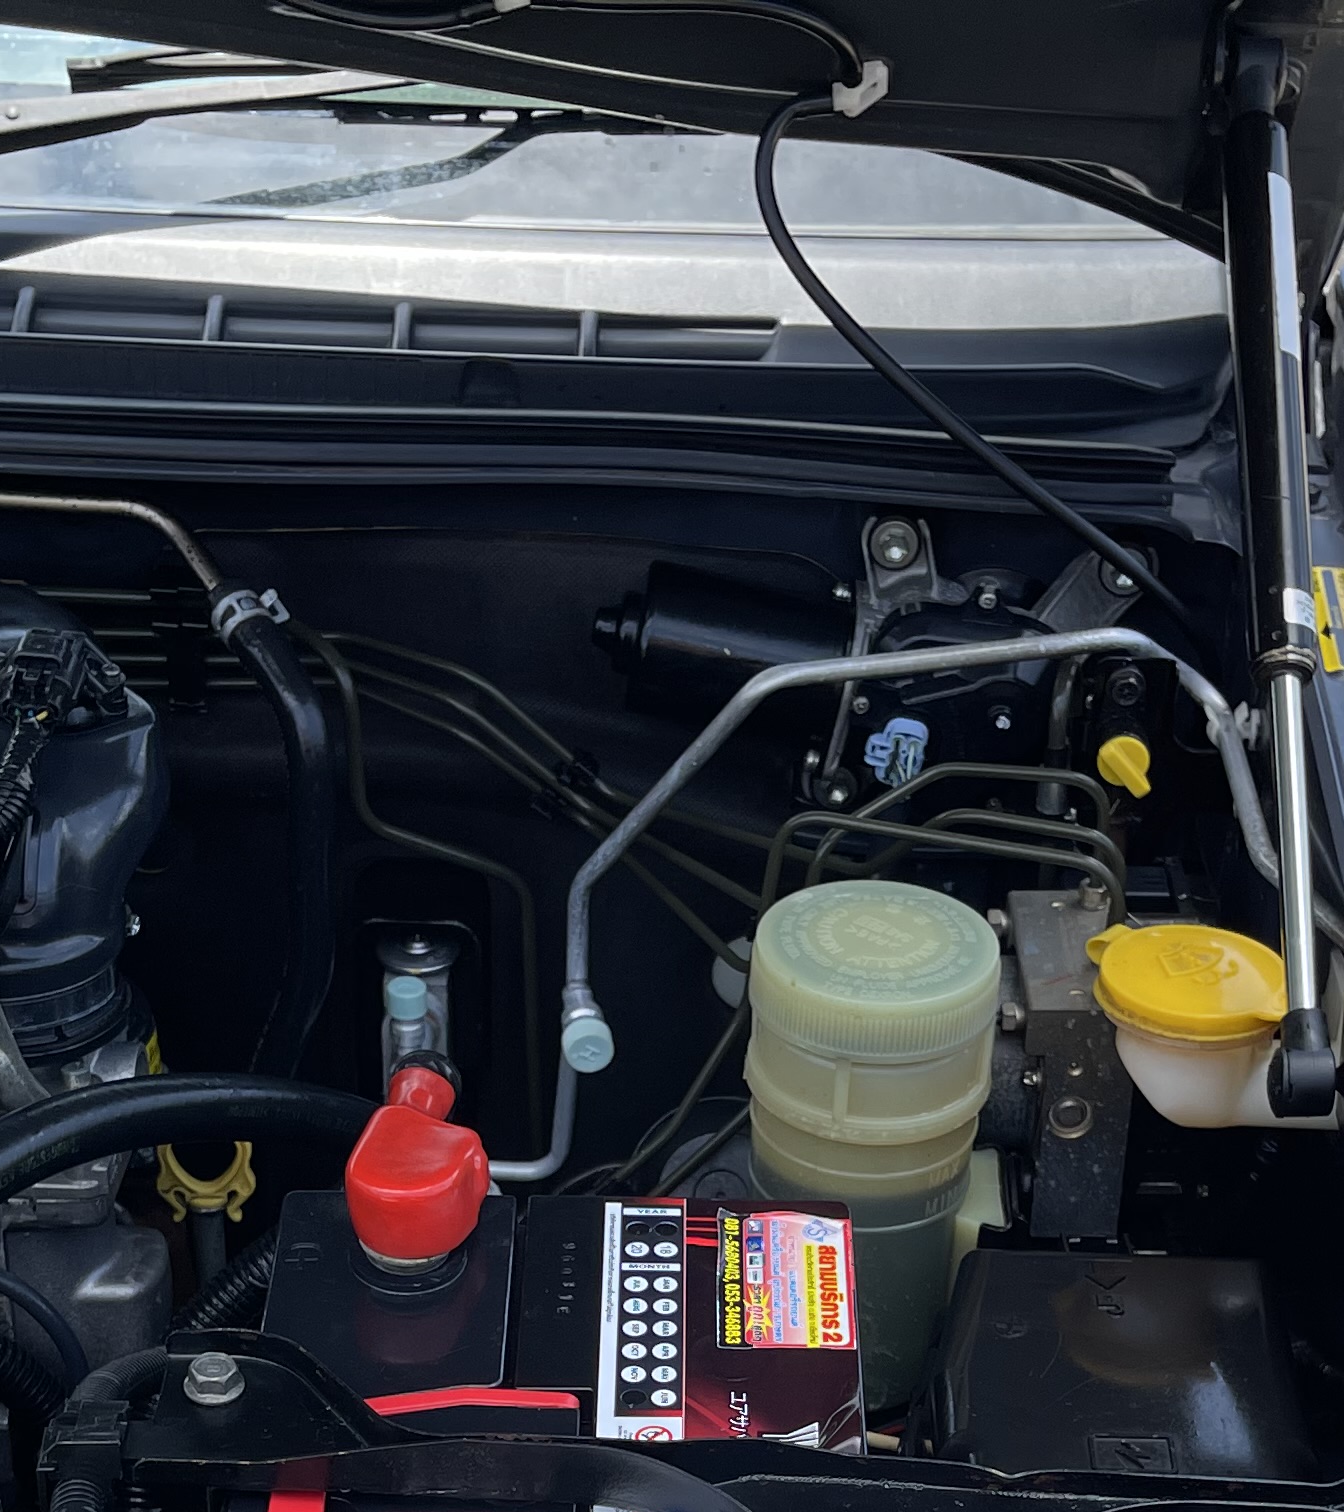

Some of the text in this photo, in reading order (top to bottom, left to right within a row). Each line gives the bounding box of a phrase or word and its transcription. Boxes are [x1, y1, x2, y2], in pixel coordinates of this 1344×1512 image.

[631, 1244, 643, 1255] 20
[662, 1278, 670, 1290] JAN
[818, 1244, 844, 1343] สยามบริการ 2
[662, 1301, 670, 1312] FEB
[631, 1323, 640, 1334] SEP
[661, 1345, 670, 1357] APR
[660, 1392, 669, 1404] JUN
